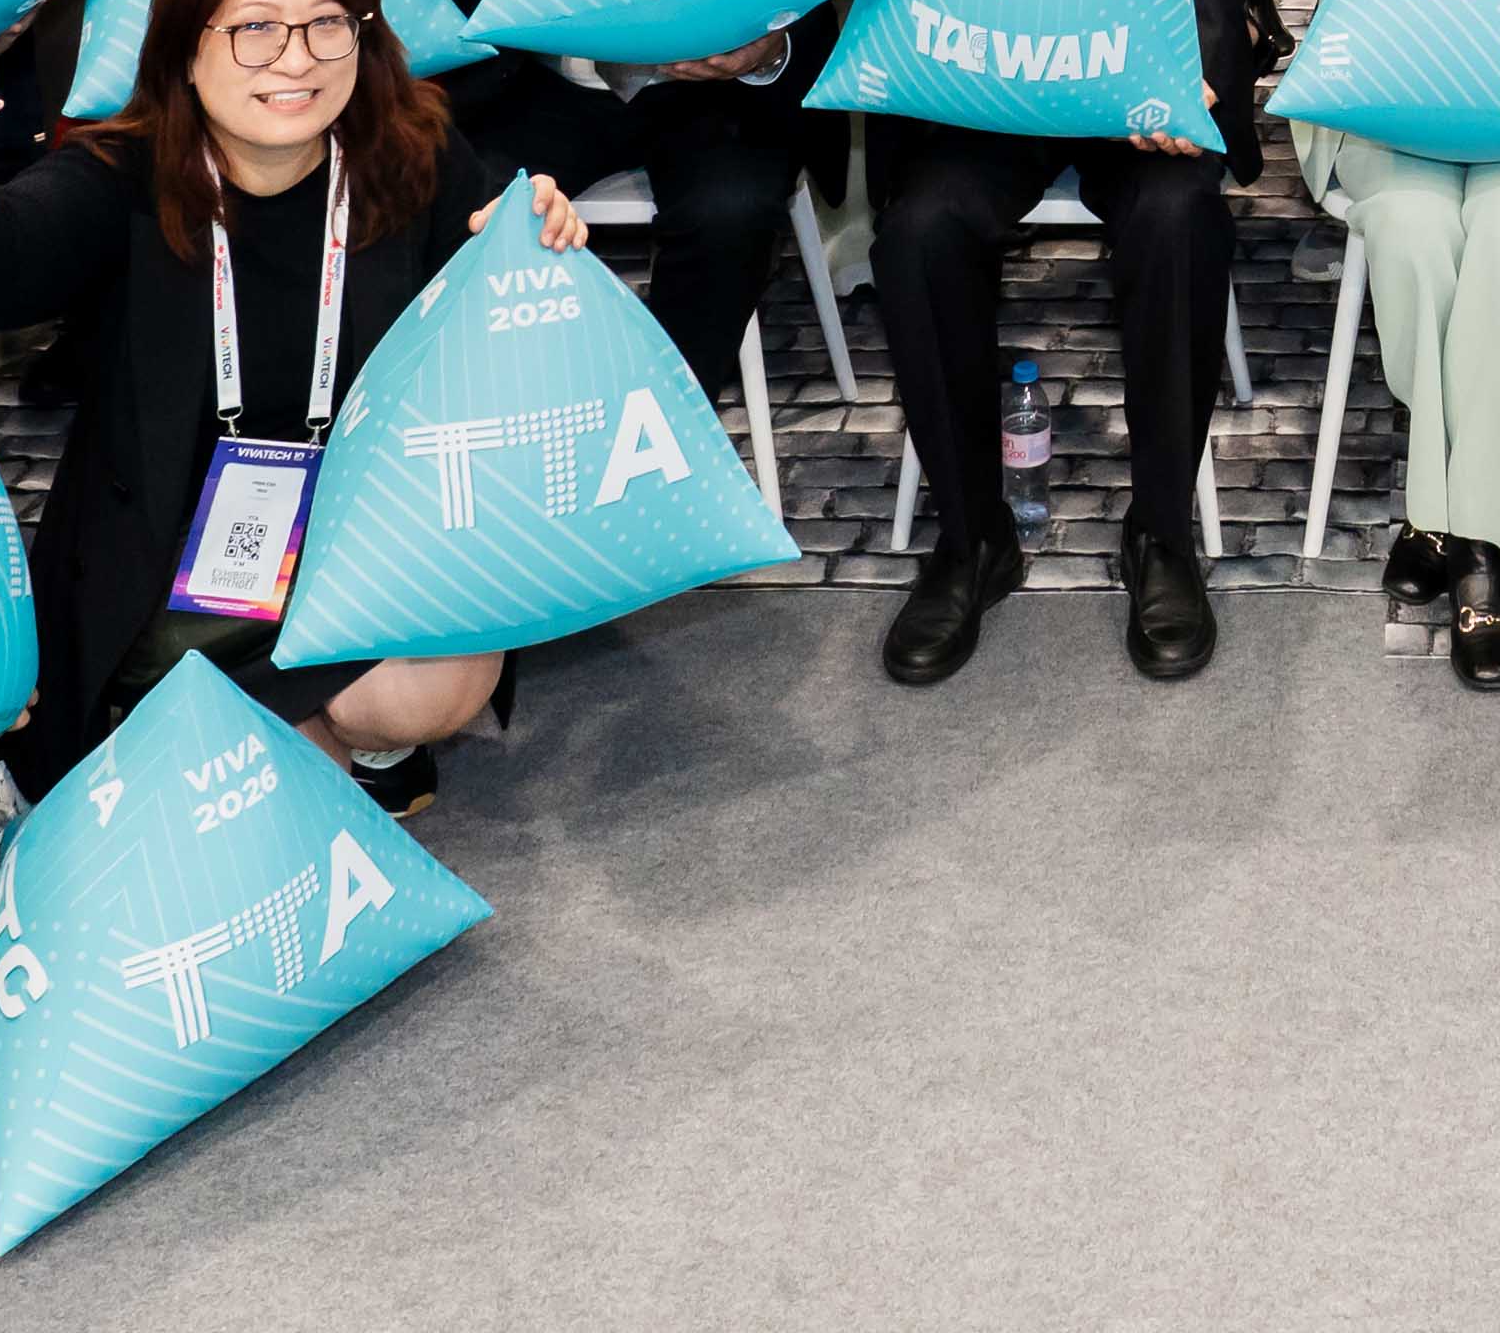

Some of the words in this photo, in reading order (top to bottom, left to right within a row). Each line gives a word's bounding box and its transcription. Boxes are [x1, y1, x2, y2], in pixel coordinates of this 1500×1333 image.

[910, 0, 1129, 82] TAIWAN
[486, 262, 575, 298] VIVA
[487, 294, 581, 334] 2026
[220, 325, 233, 381] VIVATECH
[319, 336, 333, 390] VIVATECH
[237, 447, 291, 461] VIVATECH
[402, 387, 693, 532] TTA
[183, 732, 266, 794] VIVA
[193, 763, 279, 834] 2026
[120, 828, 396, 1050] TTA
